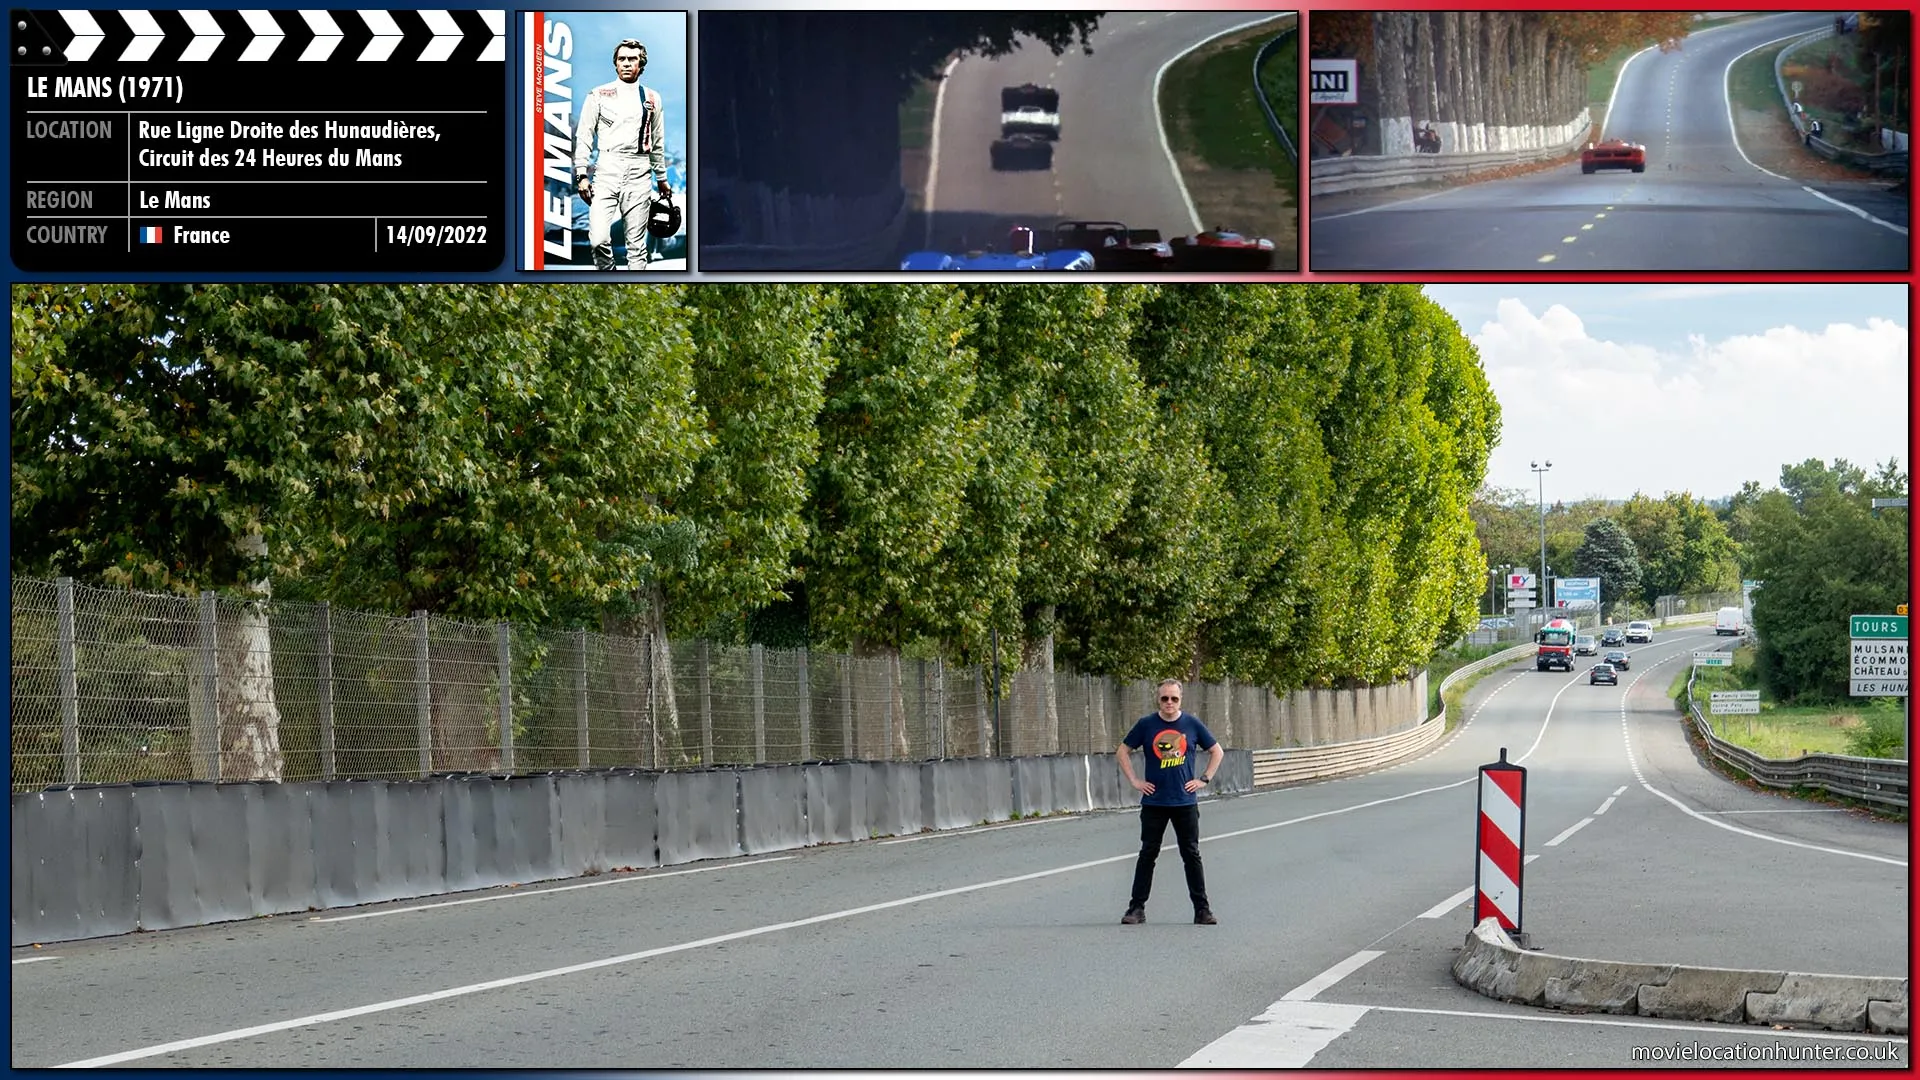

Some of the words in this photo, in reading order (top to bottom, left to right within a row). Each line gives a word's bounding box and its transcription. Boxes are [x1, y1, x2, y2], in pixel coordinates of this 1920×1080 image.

[535, 43, 543, 84] McQUEEN
[535, 86, 543, 113] STEVE
[543, 19, 574, 185] MANS
[543, 189, 573, 260] LE
[1854, 621, 1898, 632] TOURS
[1854, 665, 1900, 676] CHÂTEAU
[1857, 683, 1876, 692] LES
